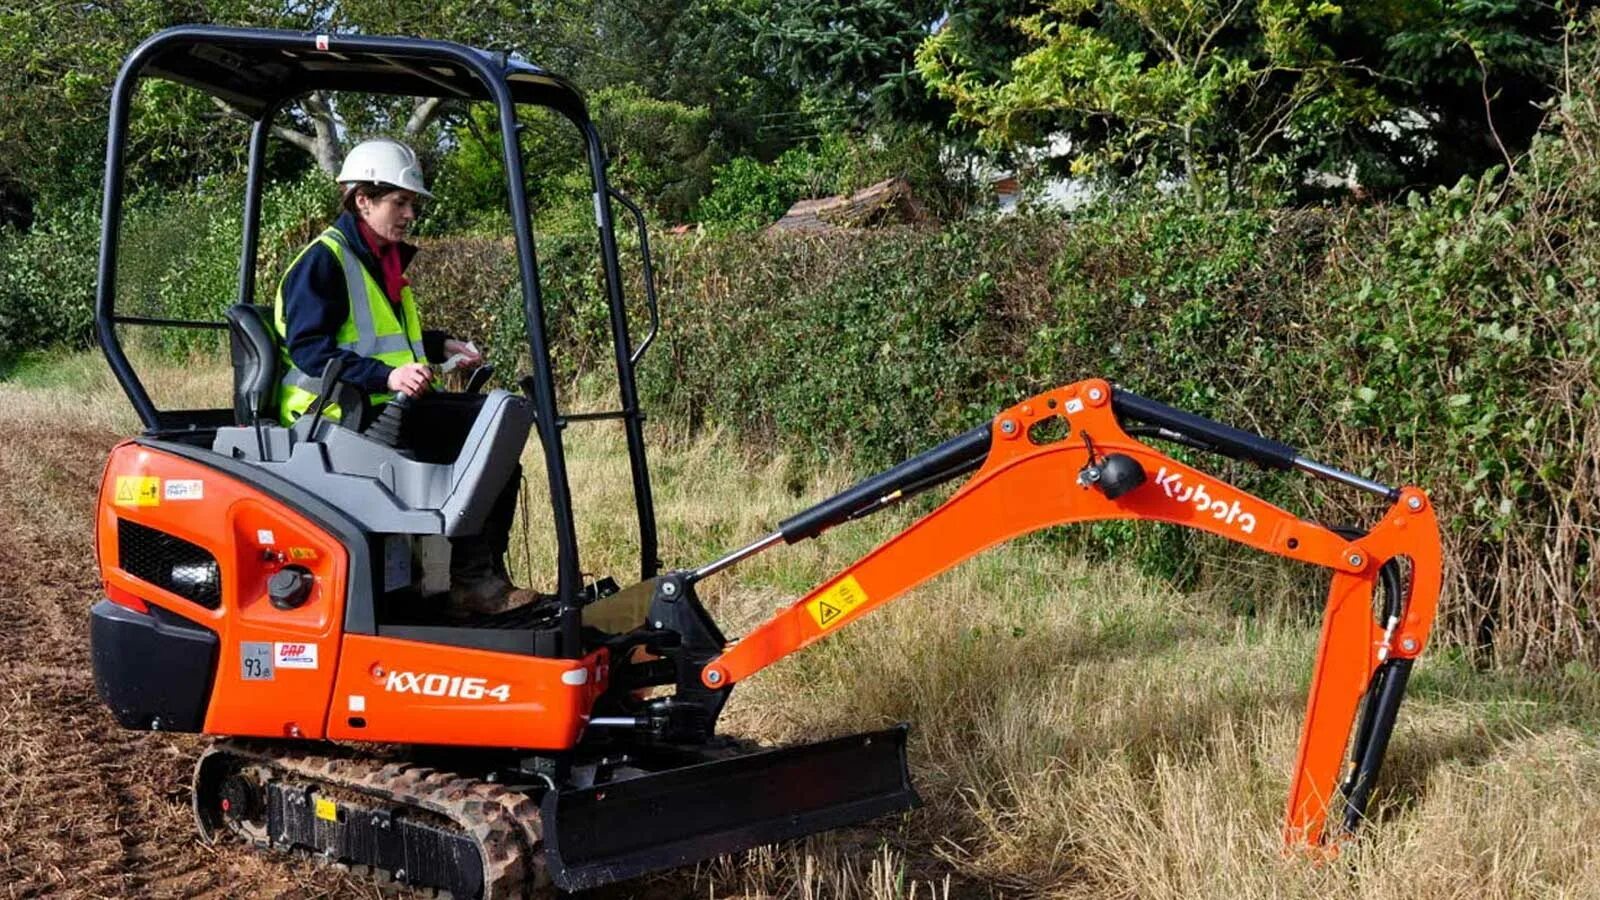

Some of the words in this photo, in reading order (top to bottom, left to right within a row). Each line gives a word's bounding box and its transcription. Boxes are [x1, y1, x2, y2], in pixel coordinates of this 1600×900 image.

[1155, 467, 1257, 534] Kubota
[244, 658, 261, 677] 93
[385, 671, 511, 702] KX016-4
